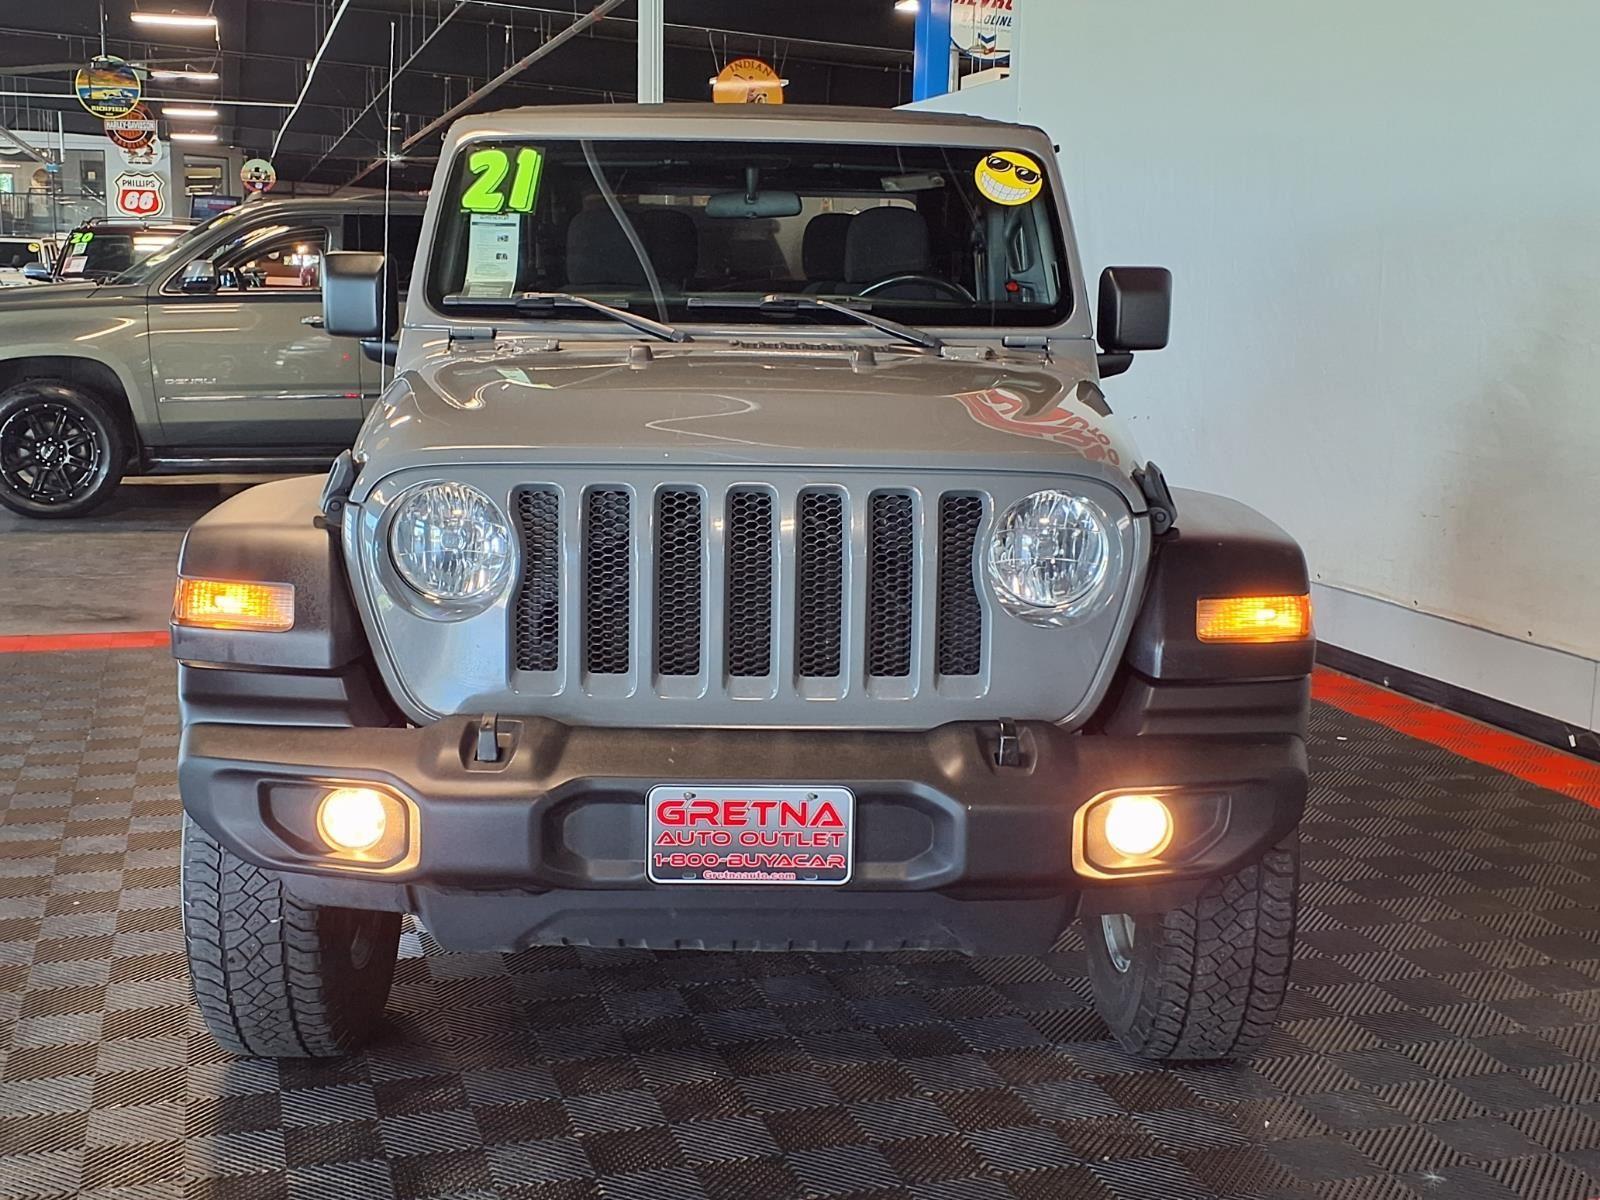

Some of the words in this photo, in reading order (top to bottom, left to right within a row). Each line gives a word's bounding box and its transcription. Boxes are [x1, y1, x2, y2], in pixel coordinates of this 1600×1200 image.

[730, 60, 772, 77] INDIAN
[122, 179, 156, 188] PHILLIPS
[462, 149, 541, 212] 21
[124, 191, 155, 210] 66
[70, 233, 94, 244] 20
[656, 800, 845, 827] GRETNA
[655, 831, 732, 846] AUTO
[738, 831, 846, 848] OUTLET
[653, 852, 846, 869] 1-800-BUYACAR
[702, 870, 797, 881] Gretnaauto.com
